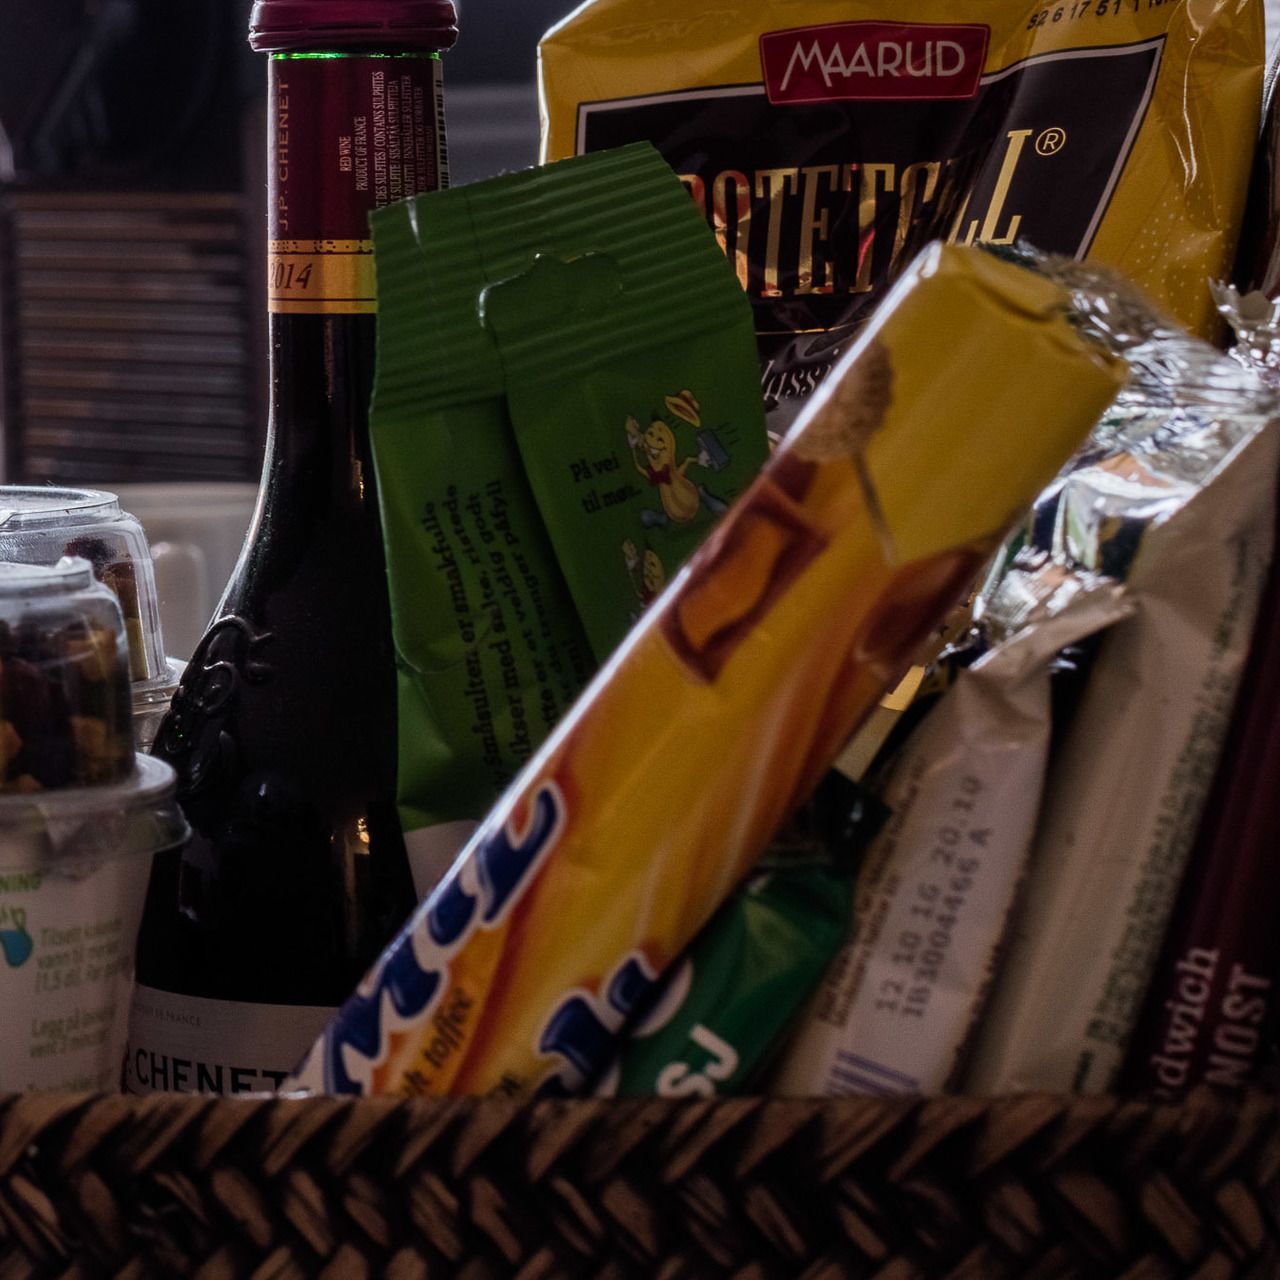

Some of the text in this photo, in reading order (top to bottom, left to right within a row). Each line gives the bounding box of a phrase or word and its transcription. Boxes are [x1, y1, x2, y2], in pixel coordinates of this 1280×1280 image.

[780, 40, 965, 91] MAARUD
[371, 71, 385, 110] SULPHITES
[373, 110, 386, 147] CONTAINS
[278, 81, 290, 231] J.P. CHENET
[339, 136, 352, 172] RED WINE
[353, 115, 368, 191] PRODUCT OF FRANCE
[270, 262, 313, 289] 2014
[570, 451, 620, 482] På vei
[459, 617, 475, 643] er
[488, 639, 517, 688] med
[423, 986, 473, 1070] toffee
[1150, 947, 1220, 1094] dwich
[134, 1047, 288, 1094] CHENET
